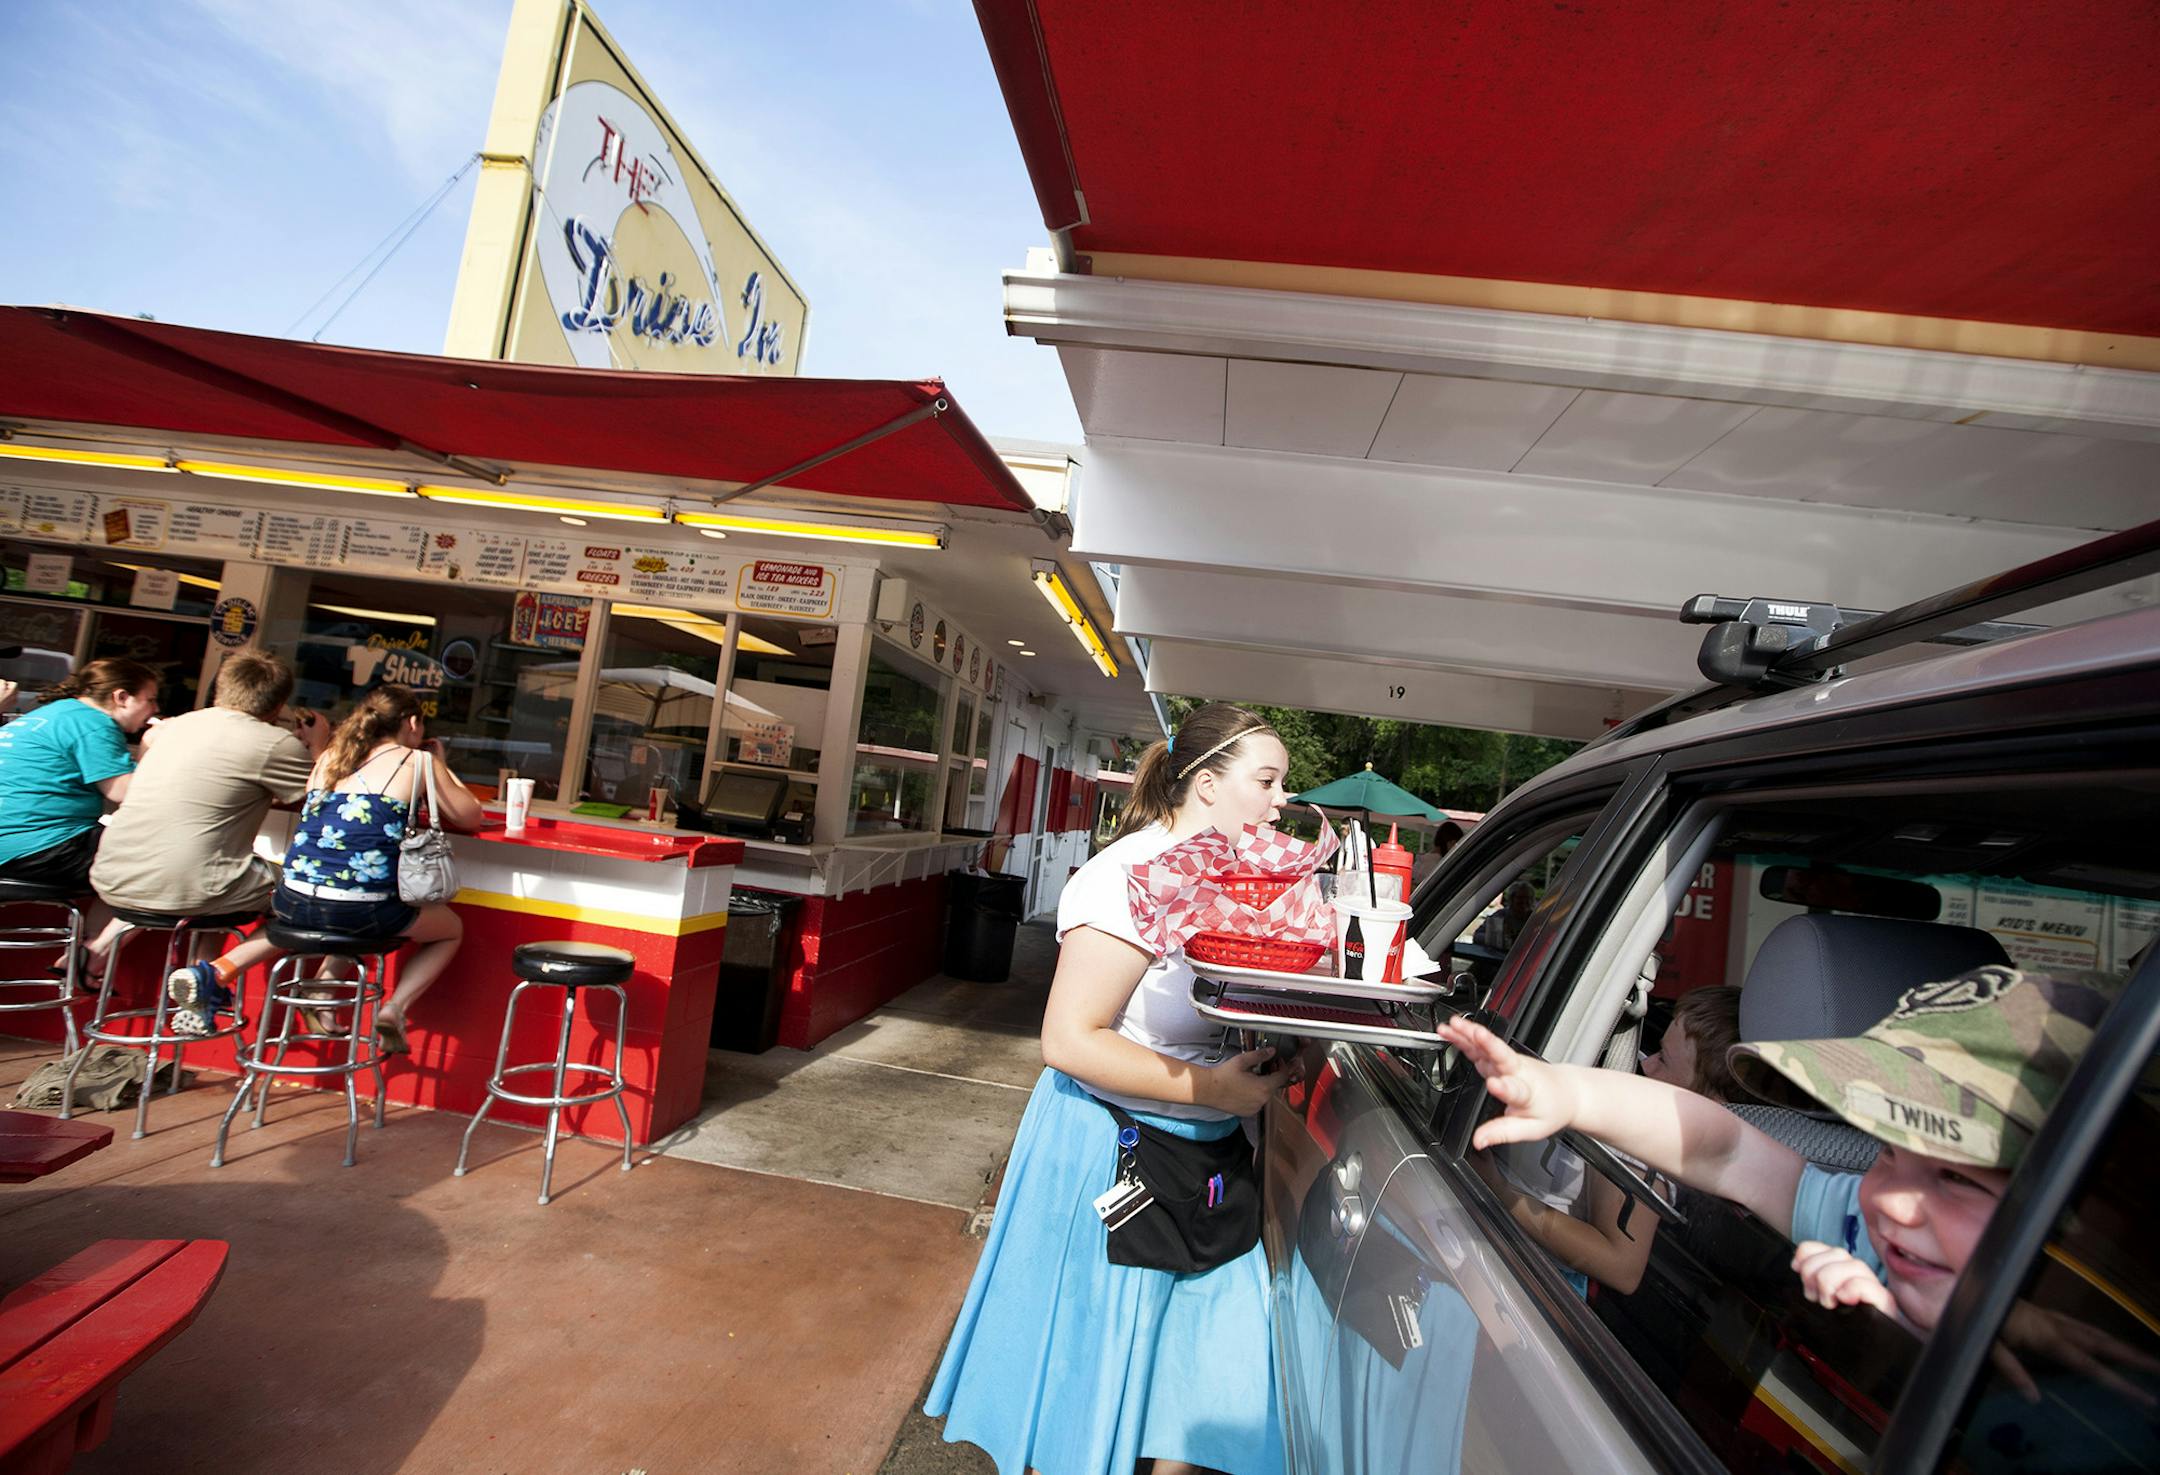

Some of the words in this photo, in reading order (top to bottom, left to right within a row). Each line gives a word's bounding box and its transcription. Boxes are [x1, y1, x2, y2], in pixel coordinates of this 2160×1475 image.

[598, 115, 661, 216] THE
[561, 214, 719, 347] Drive
[737, 271, 784, 365] In
[586, 548, 618, 559] FLOATS
[579, 572, 616, 584] FREEZES
[759, 563, 804, 574] LEMONADE
[804, 567, 818, 575] AND
[756, 572, 768, 580] ICE
[770, 573, 785, 582] TEA
[785, 575, 820, 586] MIXERS
[542, 608, 585, 632] ICEE
[1767, 604, 1808, 617] THULE
[367, 633, 409, 652] Drive
[382, 653, 444, 688] Shirts
[1389, 686, 1405, 699] 19
[1997, 916, 2036, 931] KID'S
[2040, 921, 2088, 937] MENU
[1884, 1096, 1964, 1143] TWINS
